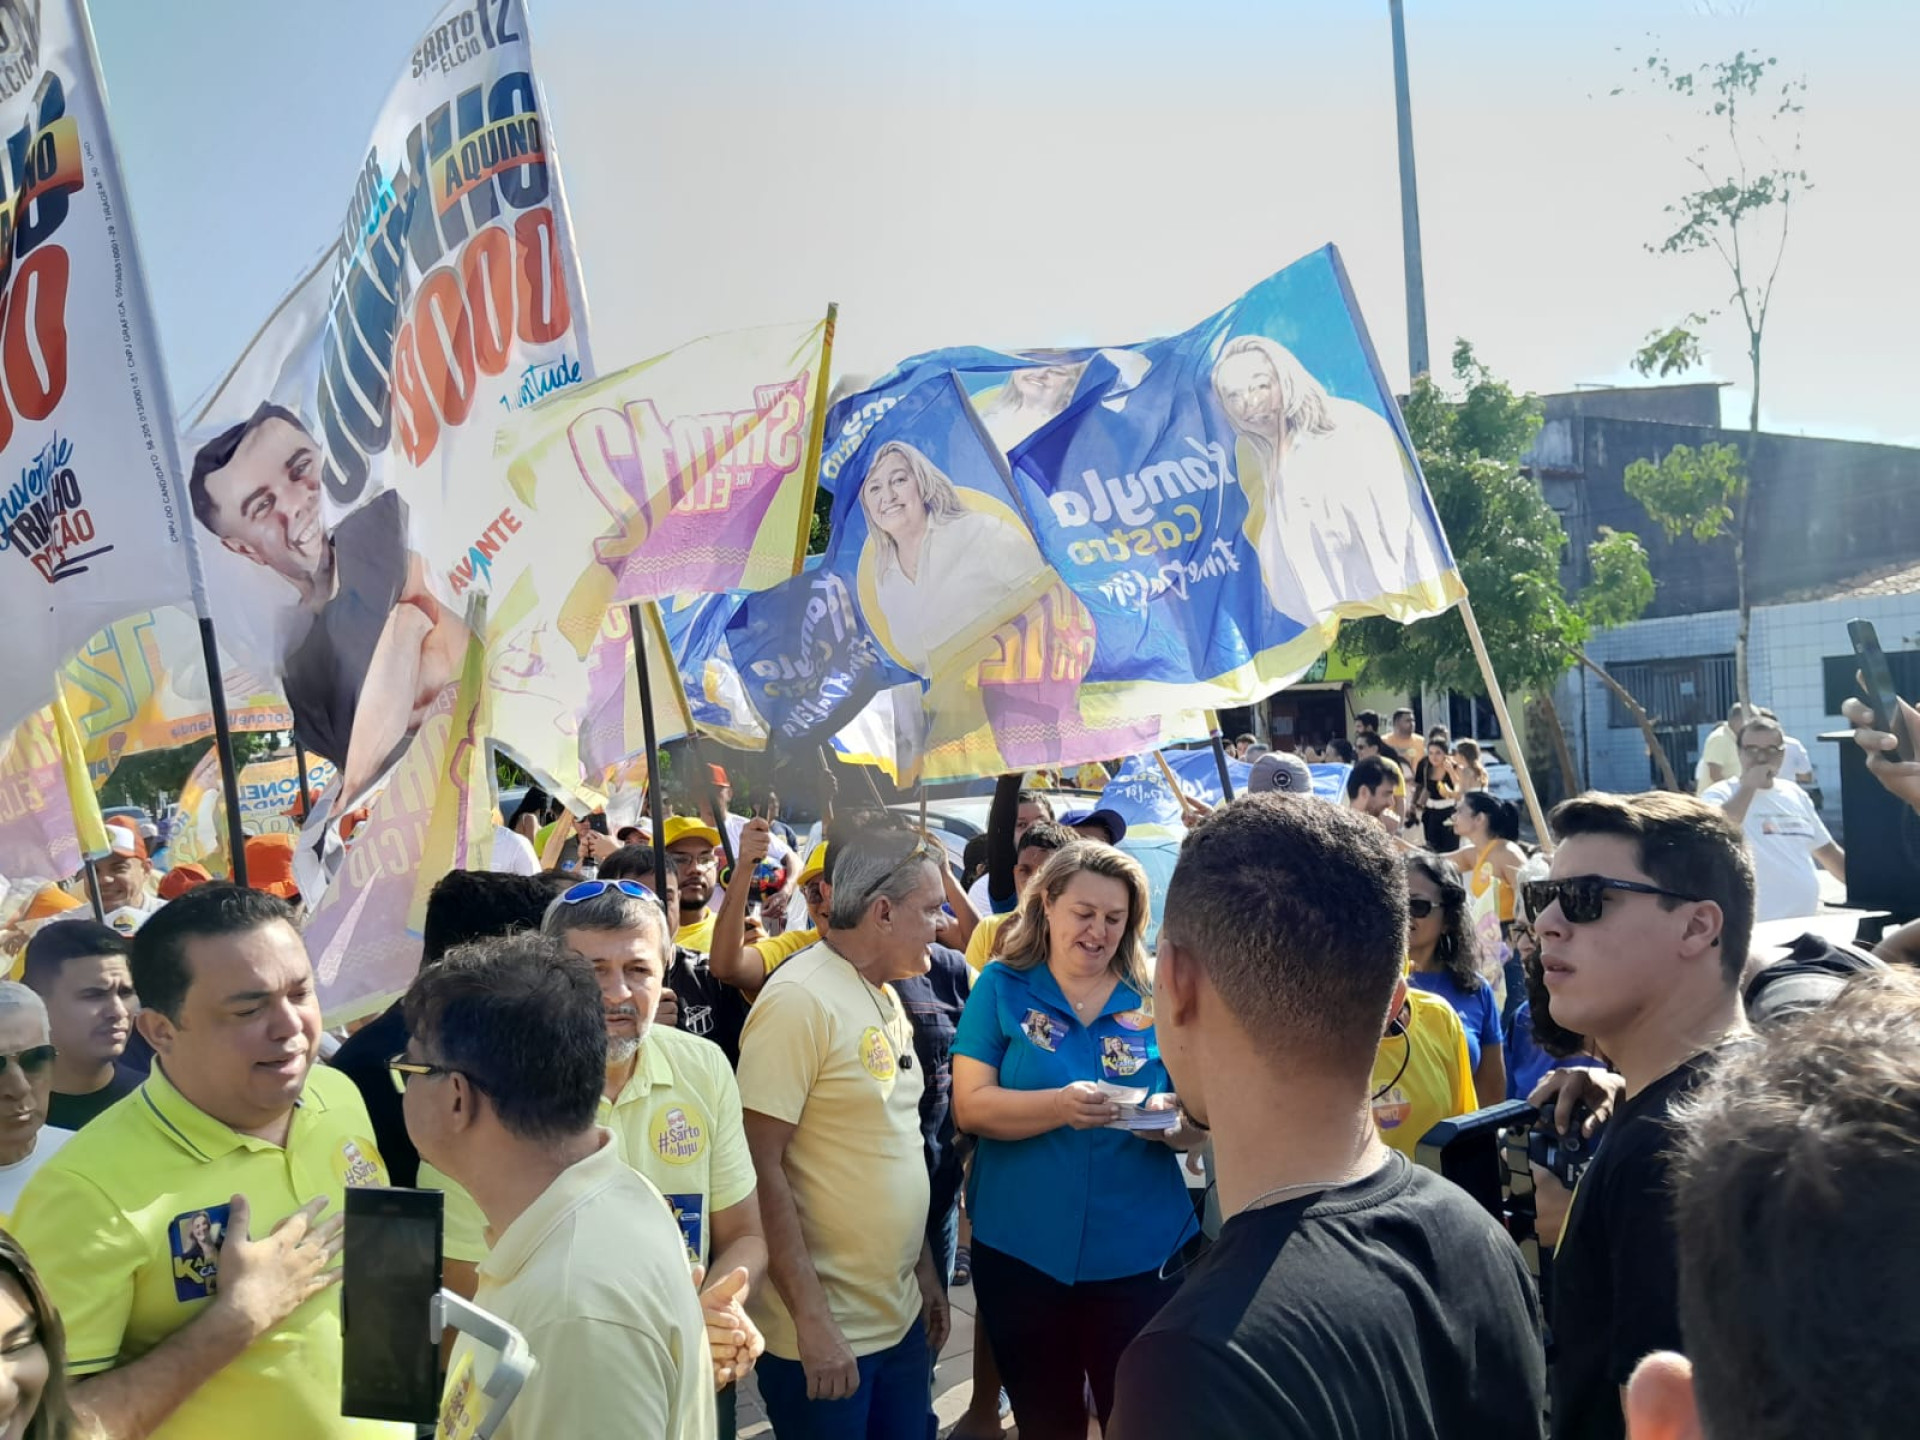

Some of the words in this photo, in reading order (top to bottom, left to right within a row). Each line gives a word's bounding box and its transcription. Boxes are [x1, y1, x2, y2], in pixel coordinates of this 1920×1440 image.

[411, 10, 475, 79] SARTO
[474, 0, 520, 50] 12
[440, 37, 481, 74] ELCIO
[0, 55, 33, 103] LCIO
[445, 117, 542, 198] AQUINO
[447, 506, 523, 596] AVANTE
[658, 1126, 700, 1155] #Sarto
